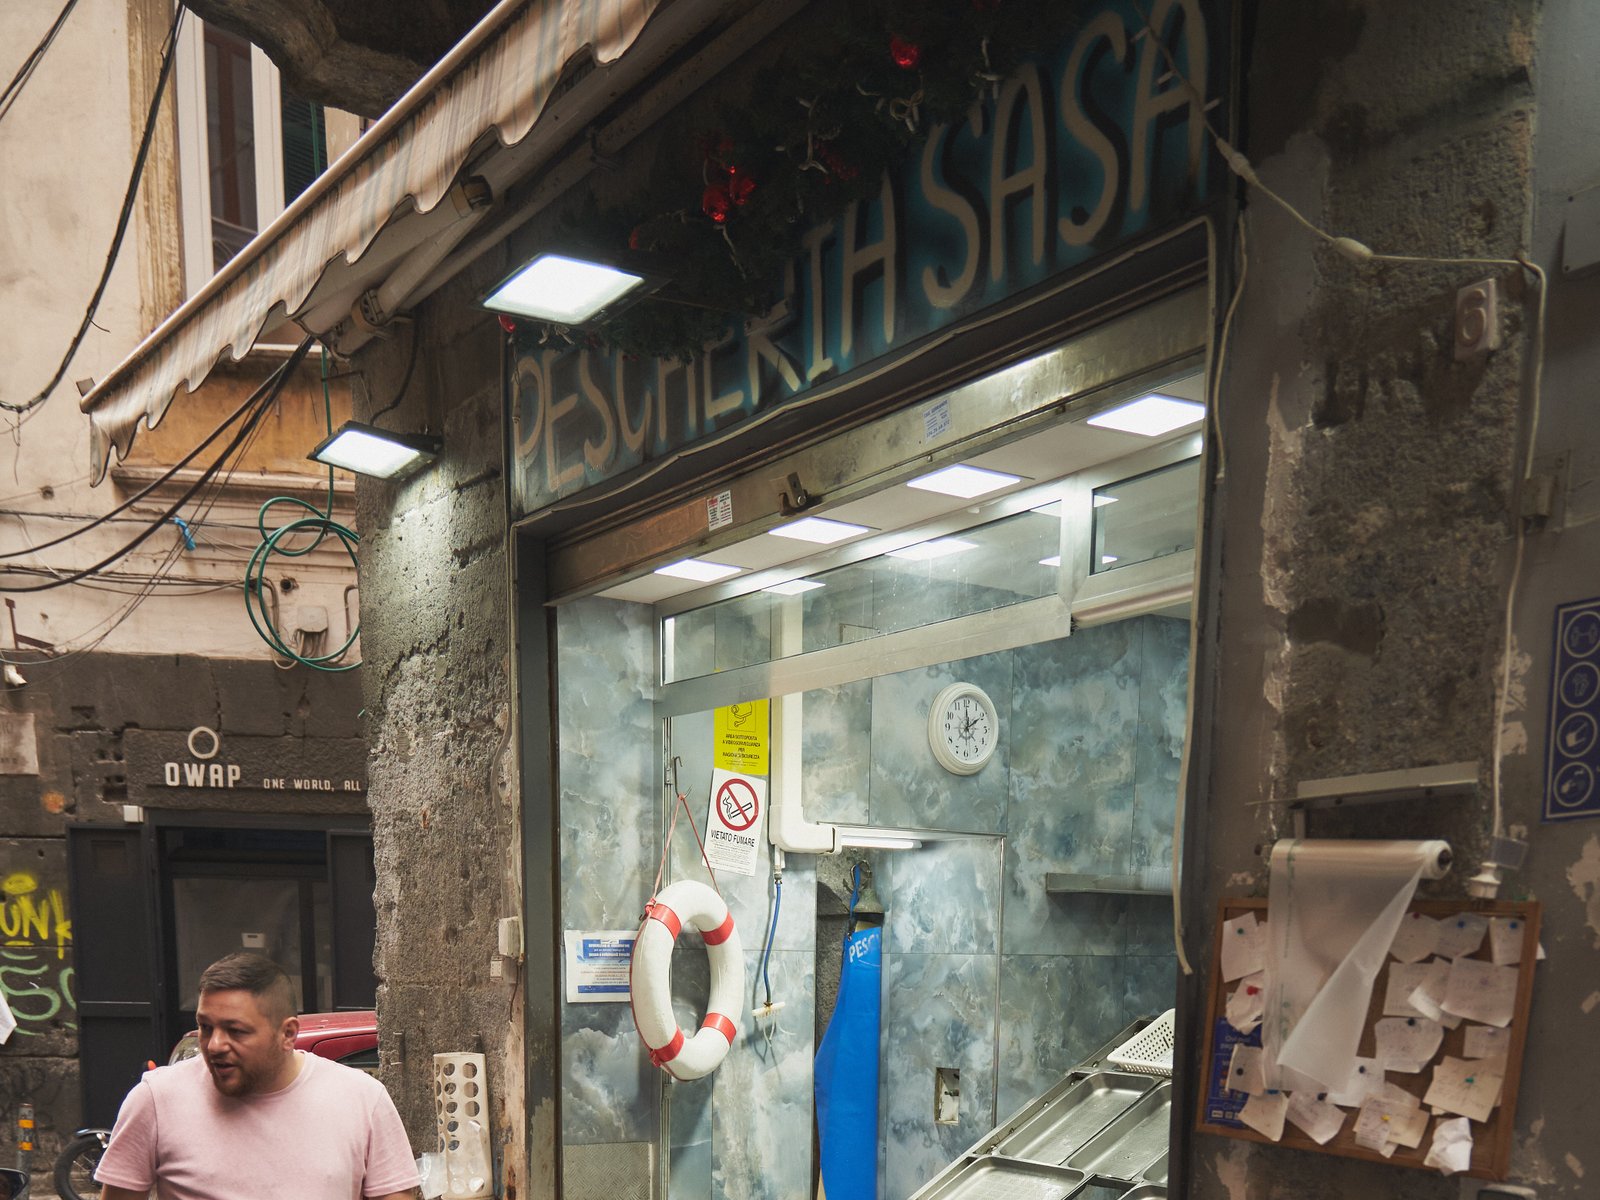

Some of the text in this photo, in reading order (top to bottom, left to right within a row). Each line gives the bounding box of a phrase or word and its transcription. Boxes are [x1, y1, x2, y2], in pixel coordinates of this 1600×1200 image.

[921, 0, 1209, 308] SASA
[1461, 288, 1487, 347] 6
[164, 762, 241, 789] OWAP
[263, 778, 361, 793] ONE WORLD, ALL
[711, 830, 755, 848] VIETATO FUMARE
[849, 933, 879, 963] PESC
